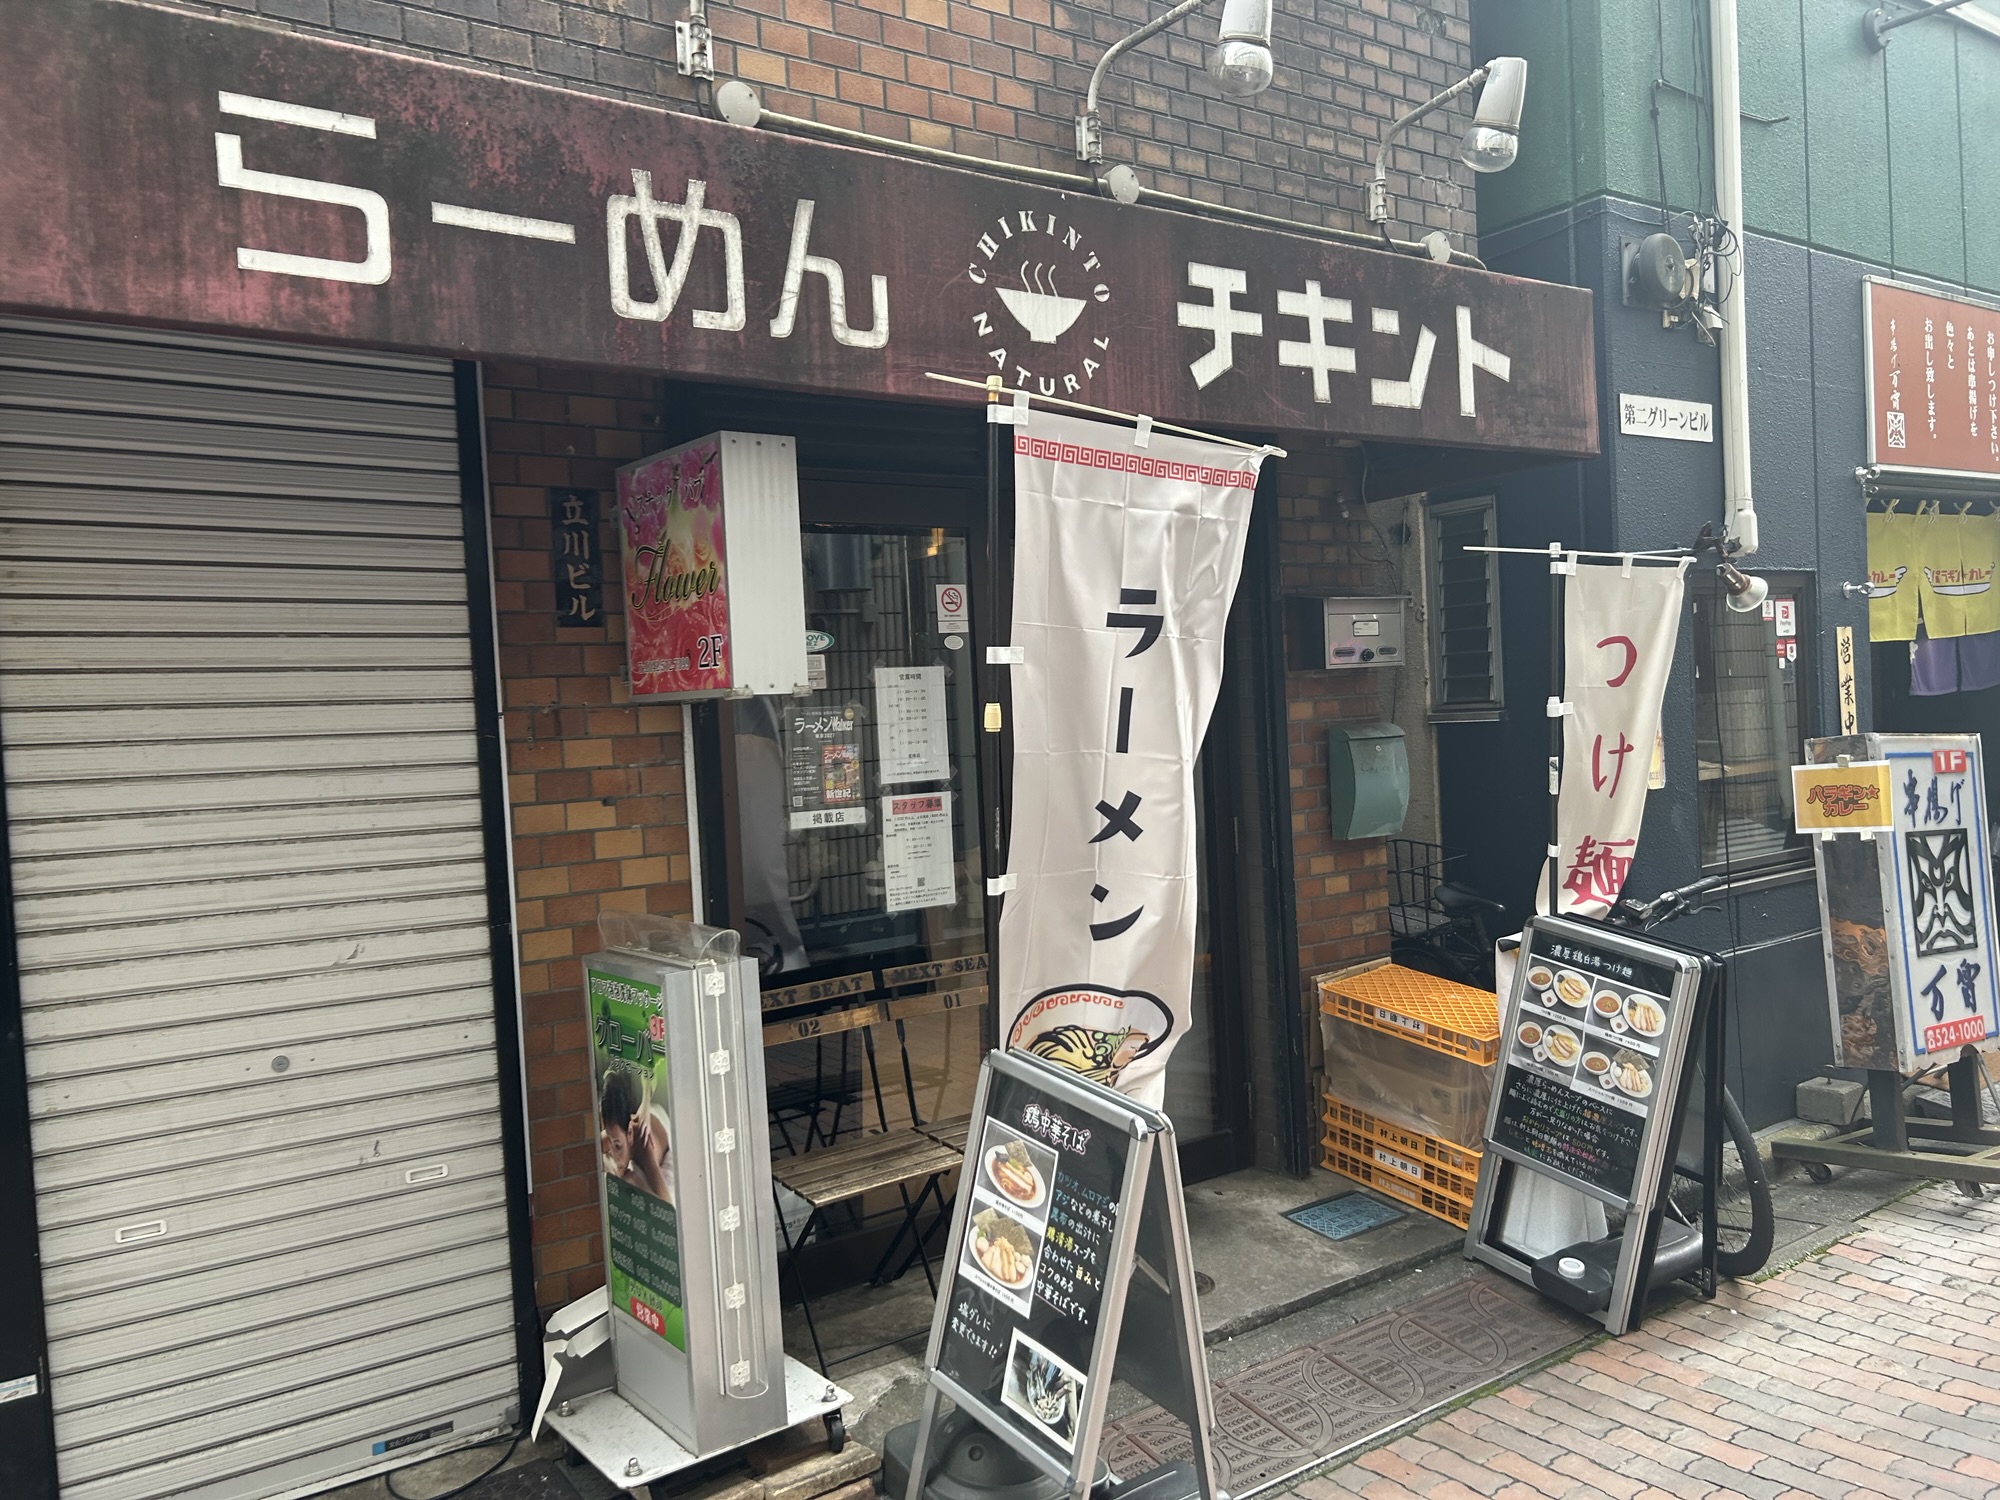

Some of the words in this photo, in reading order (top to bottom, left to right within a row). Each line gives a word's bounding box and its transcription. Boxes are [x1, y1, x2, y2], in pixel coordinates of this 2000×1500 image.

[214, 89, 890, 350] らーめん
[968, 210, 1110, 302] CHIKINTO
[972, 311, 1110, 396] NATURAL
[1177, 261, 1511, 418] チキント
[1945, 320, 1955, 370] 色々と
[1924, 317, 1937, 439] お出し致します。
[1966, 325, 1978, 437] あとは串揚げを
[1623, 403, 1709, 432] 第二グリーンビル
[561, 494, 596, 622] 立川ビル
[631, 538, 722, 610] Flower
[1871, 570, 1896, 584] カレー
[697, 634, 724, 670] 2F
[1840, 635, 1855, 735] 営業中
[1088, 588, 1164, 942] ラーメン
[1562, 635, 1638, 907] つけ麺
[1936, 751, 1962, 771] 1F
[1806, 784, 1867, 804] パラギン
[1822, 801, 1869, 817] カレー
[812, 811, 845, 824] 掲載店
[808, 976, 863, 1000] SEAT
[943, 993, 962, 1009] 01
[797, 1018, 821, 1038] 02
[1935, 1018, 1985, 1048] 524-1000
[1023, 1105, 1091, 1153] 鶏中華そば
[1379, 1128, 1418, 1151] 村上朝日
[1379, 1152, 1418, 1176] 村上朝日
[1050, 1206, 1101, 1246] 昆布の出汁に
[1055, 1188, 1113, 1233] アジなどの煮干し
[1039, 1262, 1074, 1293] コクのある
[635, 1301, 660, 1331] 営業中
[1036, 1278, 1089, 1325] 中華そばです。
